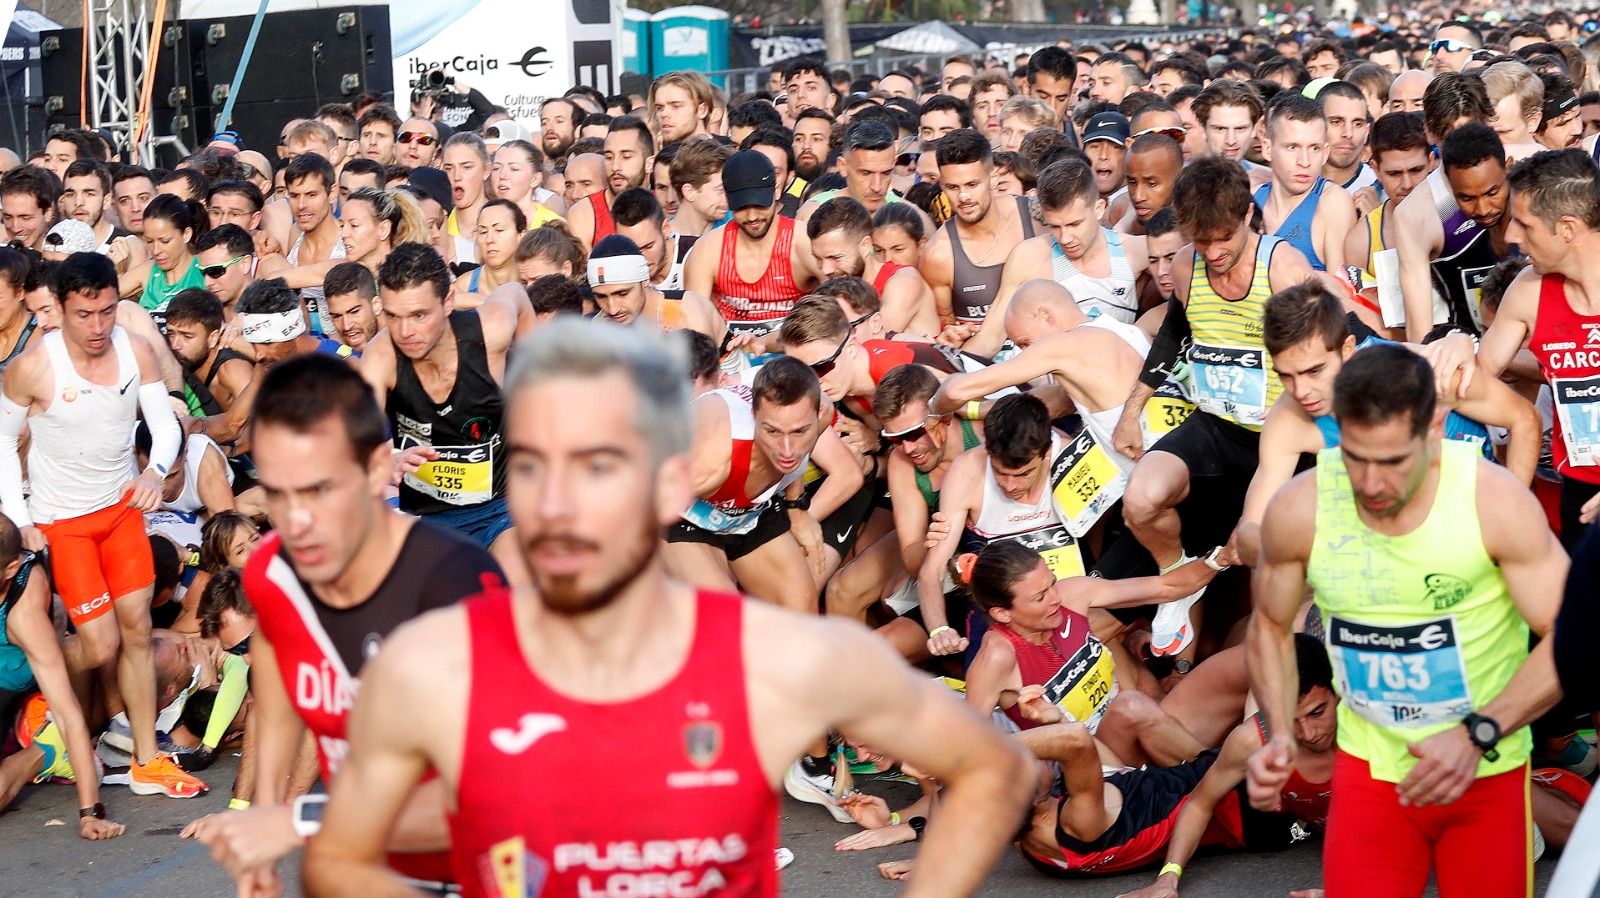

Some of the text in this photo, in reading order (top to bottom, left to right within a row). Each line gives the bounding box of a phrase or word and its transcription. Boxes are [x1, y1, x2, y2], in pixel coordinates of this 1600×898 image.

[1204, 365, 1245, 395] 652
[1162, 404, 1193, 427] 33
[432, 465, 466, 475] FLORIS
[433, 475, 463, 490] 335
[1076, 476, 1100, 503] 332
[1338, 627, 1406, 650] iberCaja
[1052, 659, 1088, 695] iberCaja
[1357, 653, 1432, 692] 763
[1089, 681, 1109, 708] 220
[553, 832, 748, 873] PUERTAS
